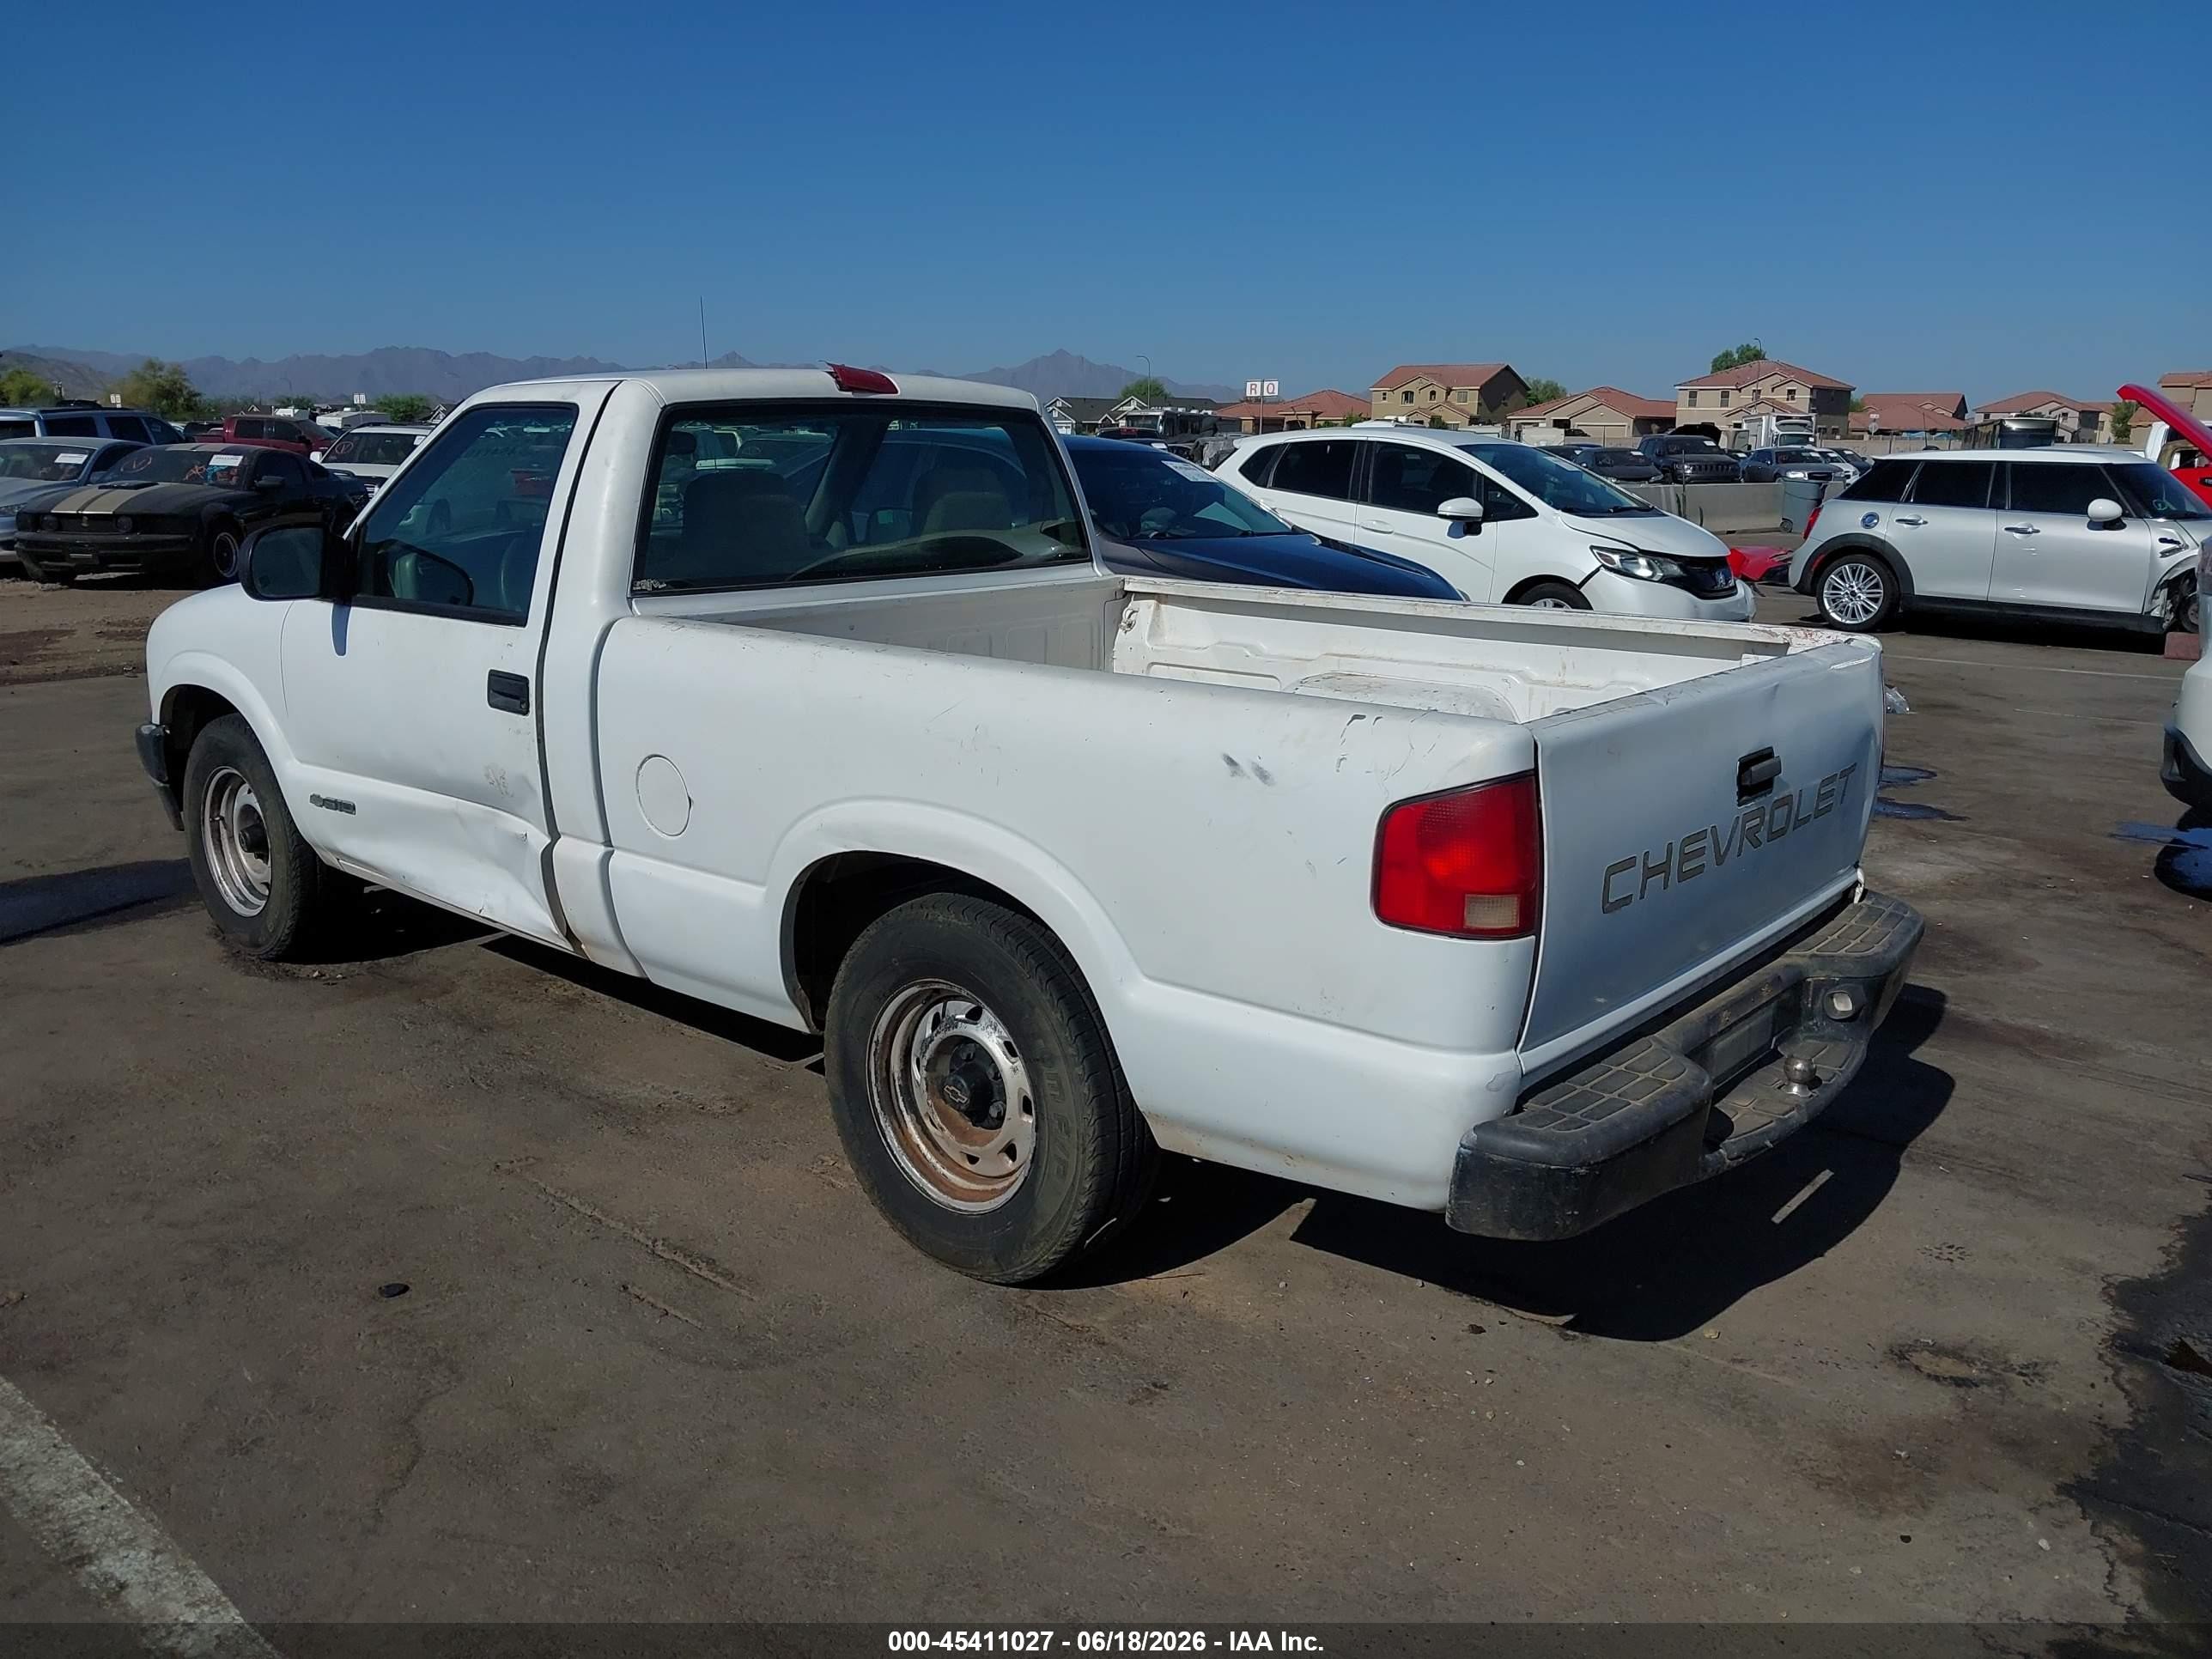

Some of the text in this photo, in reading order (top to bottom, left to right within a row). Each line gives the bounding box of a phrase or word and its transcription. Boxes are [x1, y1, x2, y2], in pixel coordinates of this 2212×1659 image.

[1250, 383, 1275, 395] R Q
[1602, 763, 1856, 914] CHEVROLET
